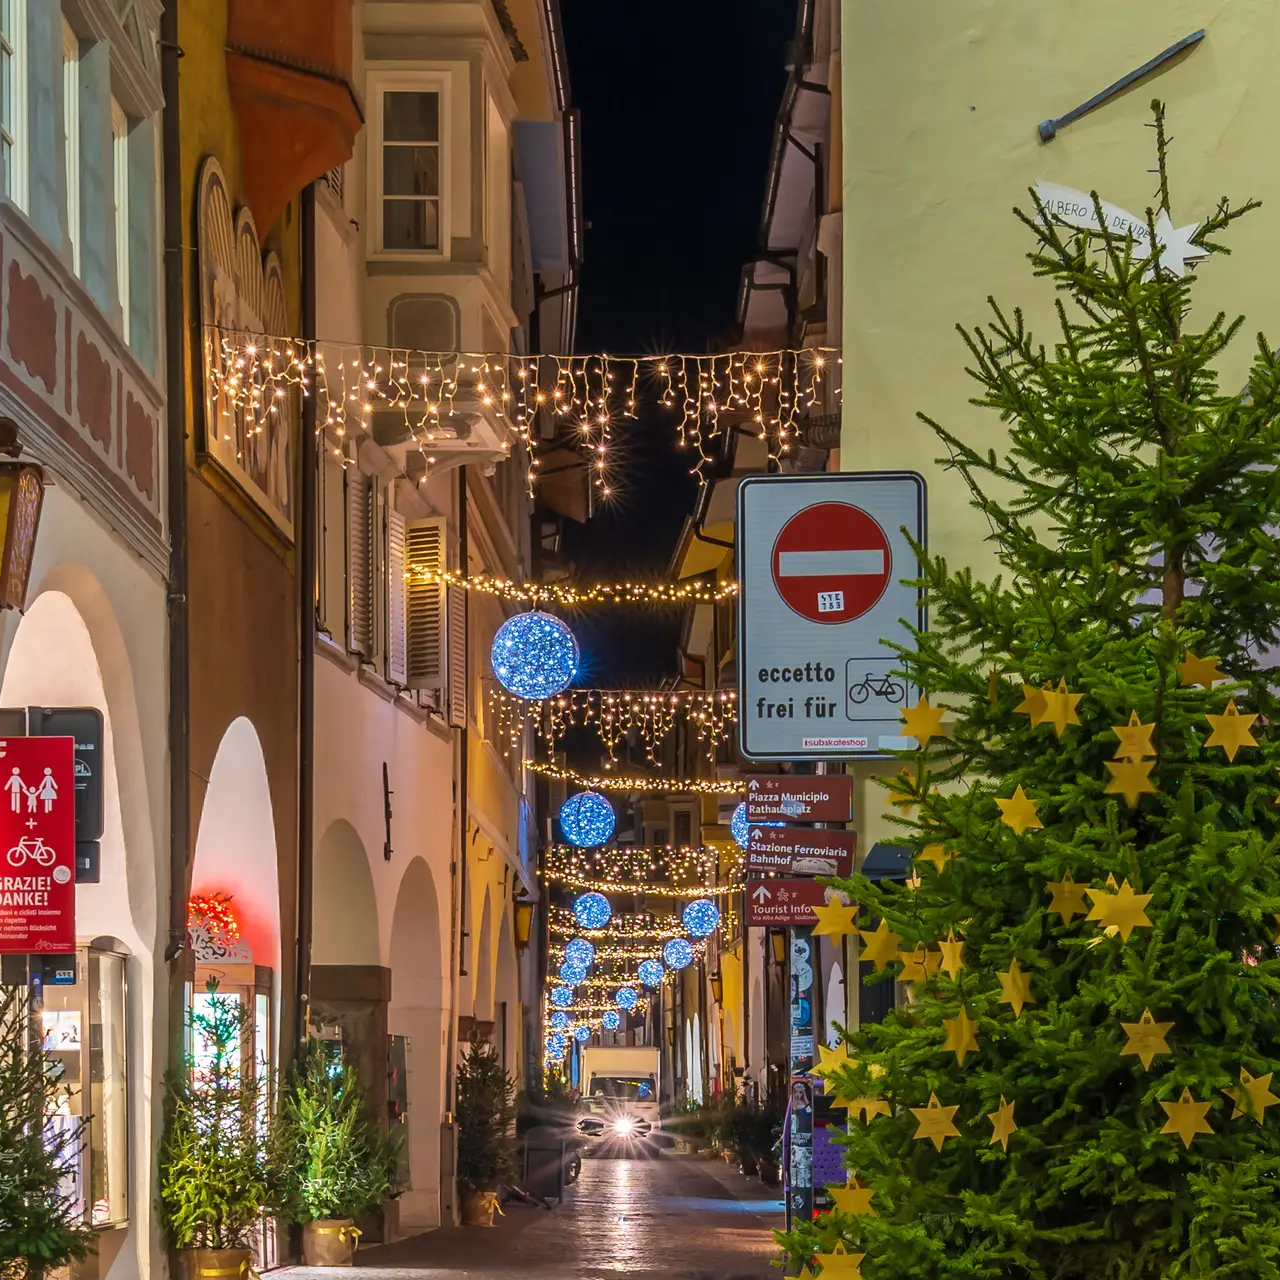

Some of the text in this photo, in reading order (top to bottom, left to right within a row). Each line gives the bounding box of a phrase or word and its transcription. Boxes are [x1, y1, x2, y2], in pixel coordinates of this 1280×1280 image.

[1091, 210, 1108, 226] DI
[758, 662, 836, 683] eccetto
[757, 697, 837, 718] frei für
[749, 792, 829, 803] Piazza Municipio
[749, 804, 811, 816] Rathausplatz
[751, 842, 847, 857] Stazione Ferroviaria
[750, 854, 791, 865] Bahnhof
[752, 903, 811, 914] Tourist Info
